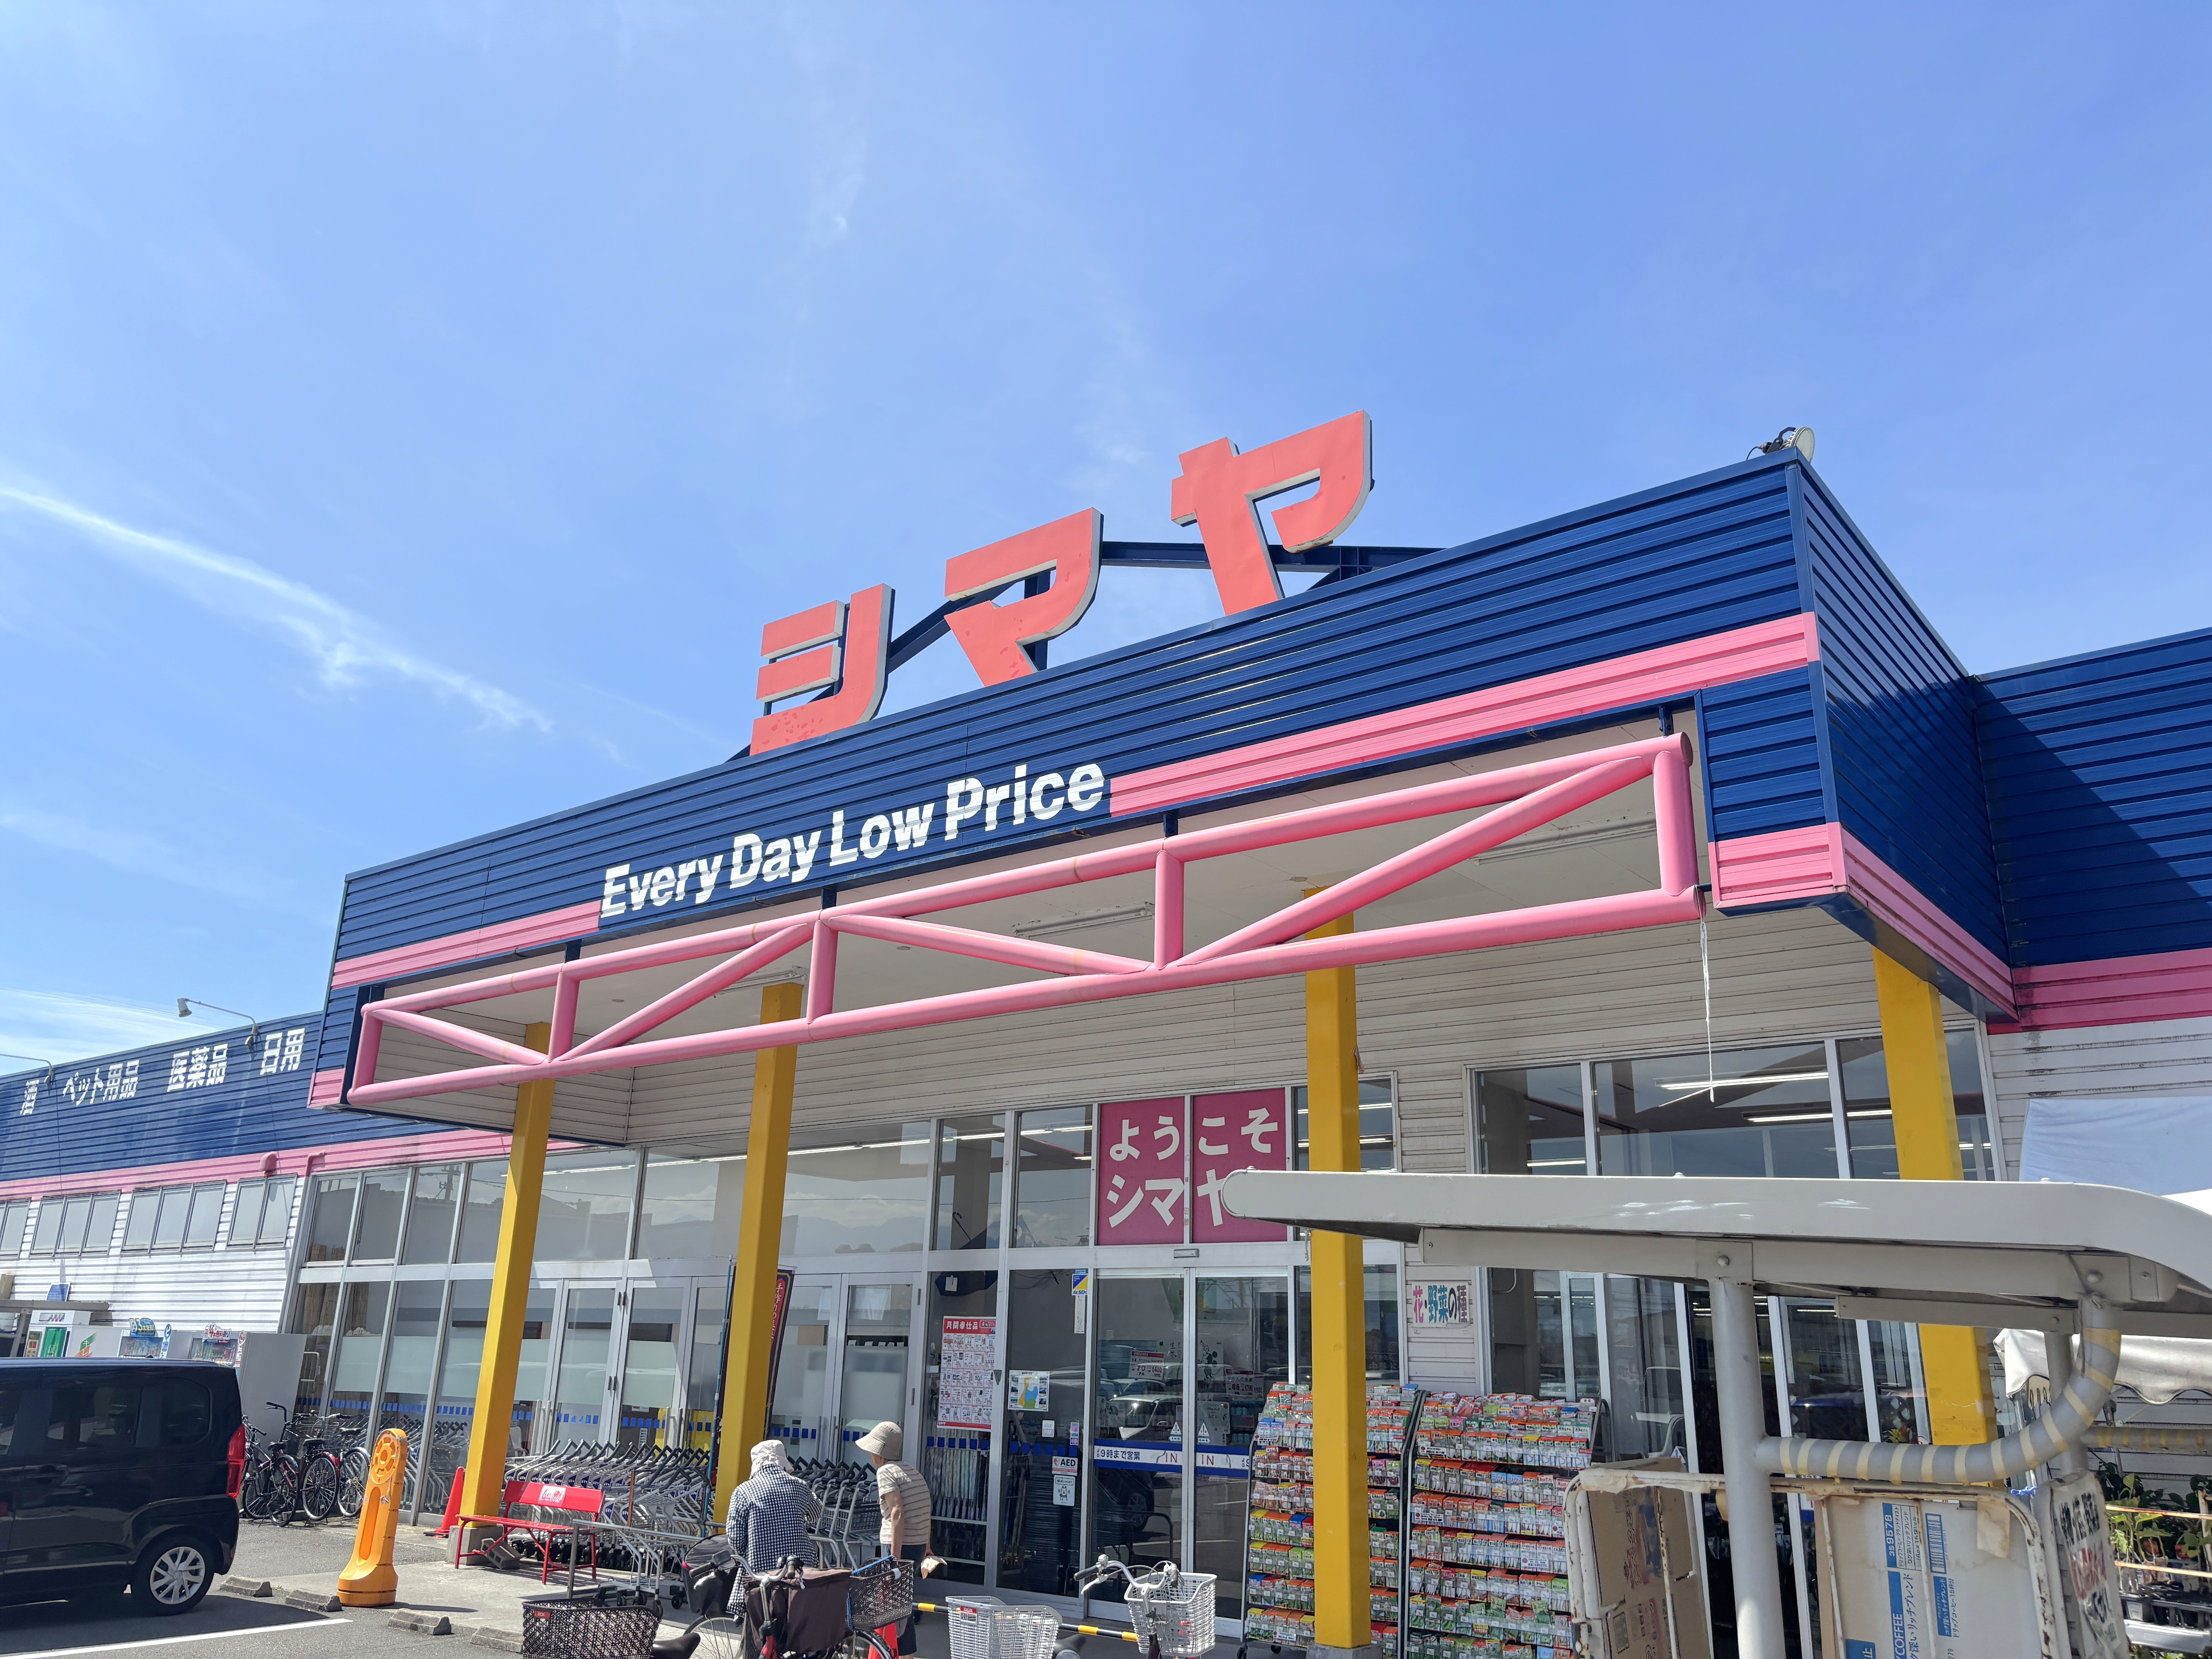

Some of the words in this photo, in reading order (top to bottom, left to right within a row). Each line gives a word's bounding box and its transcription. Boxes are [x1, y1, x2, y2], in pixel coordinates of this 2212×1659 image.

[750, 410, 1373, 757] シマヤ
[601, 853, 723, 918] Every
[730, 829, 822, 889] Day
[830, 802, 934, 867] Low
[945, 763, 1106, 841] Price
[62, 1060, 139, 1106] ペット用品
[167, 1043, 228, 1092] 医薬品
[1109, 1108, 1278, 1161] ようこそ
[1413, 1285, 1468, 1323] 花・野菜の種
[1166, 1452, 1178, 1463] IN
[1202, 1454, 1214, 1465] IN
[1884, 1515, 1895, 1556] 359578
